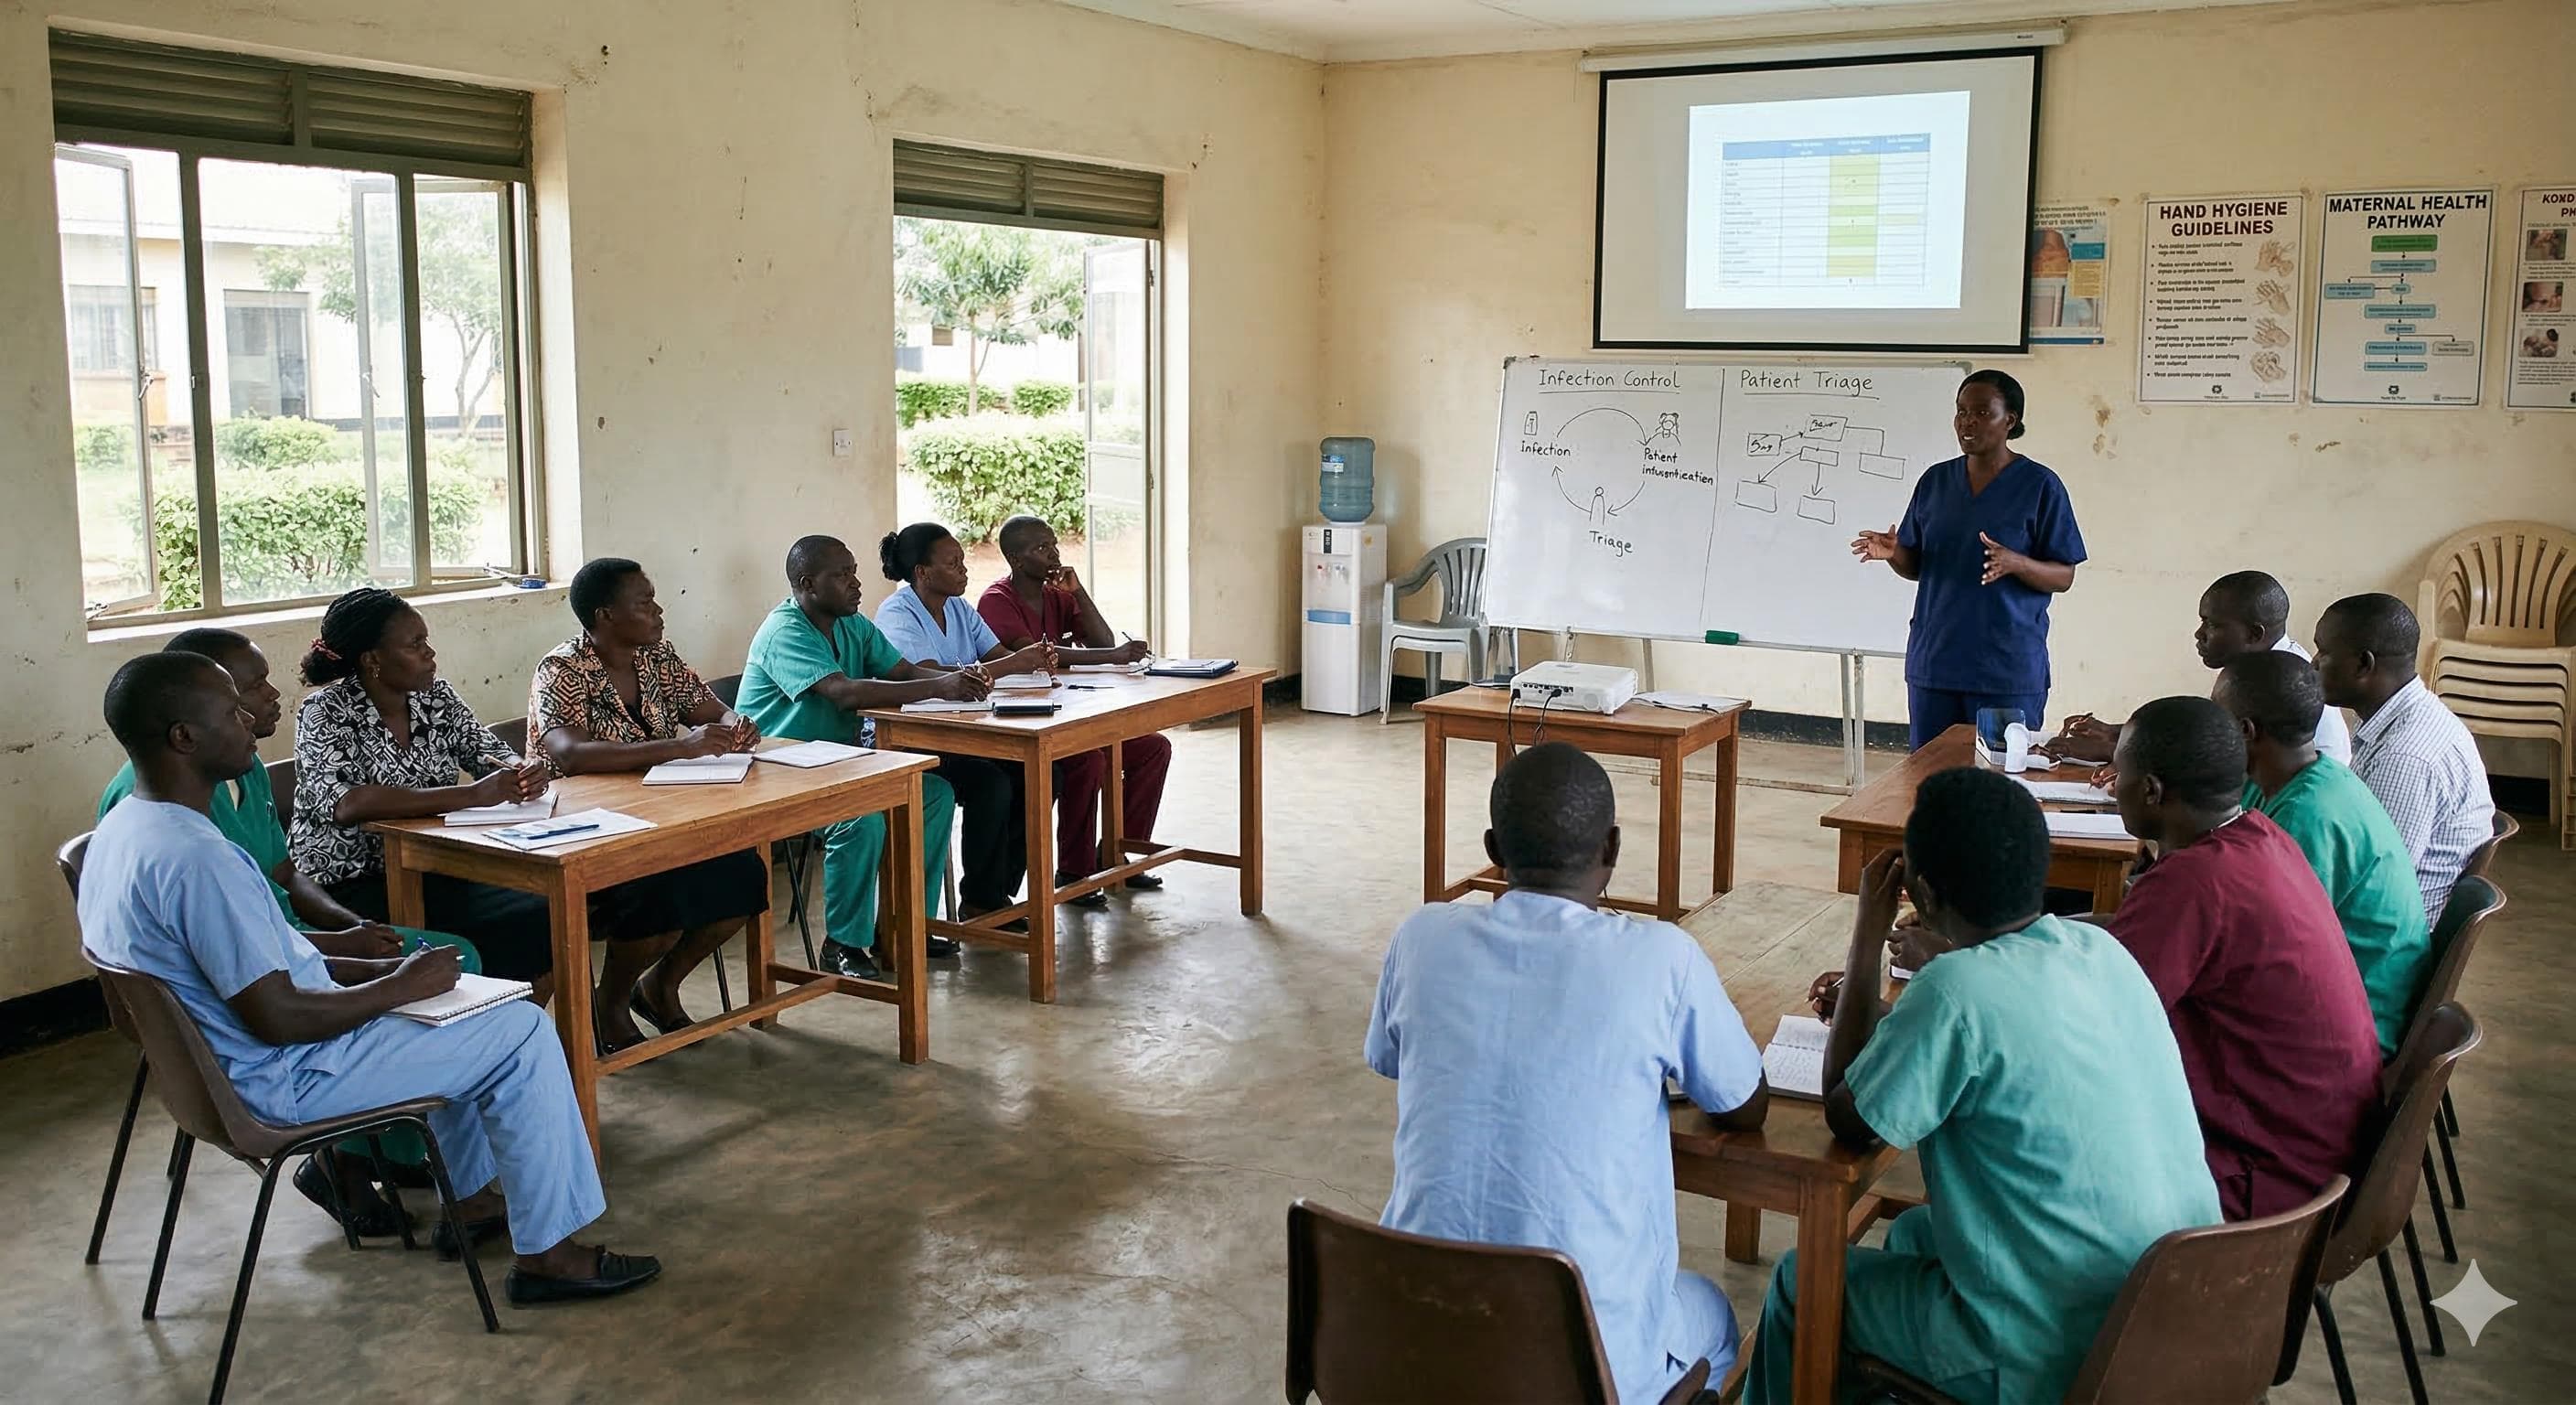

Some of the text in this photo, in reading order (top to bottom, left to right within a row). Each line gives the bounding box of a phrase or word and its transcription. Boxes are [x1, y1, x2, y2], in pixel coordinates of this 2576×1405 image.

[2160, 201, 2288, 220] HAND HYGIENE
[2329, 194, 2487, 212] MATERNAL HEALTH
[2171, 220, 2274, 237] GUIDELINES
[2367, 213, 2446, 230] PATHWAY
[1539, 369, 1681, 388] Infection Control
[1740, 369, 1873, 397] Patient Triage
[1644, 447, 1678, 464] Patient
[1589, 530, 1633, 558] Triage
